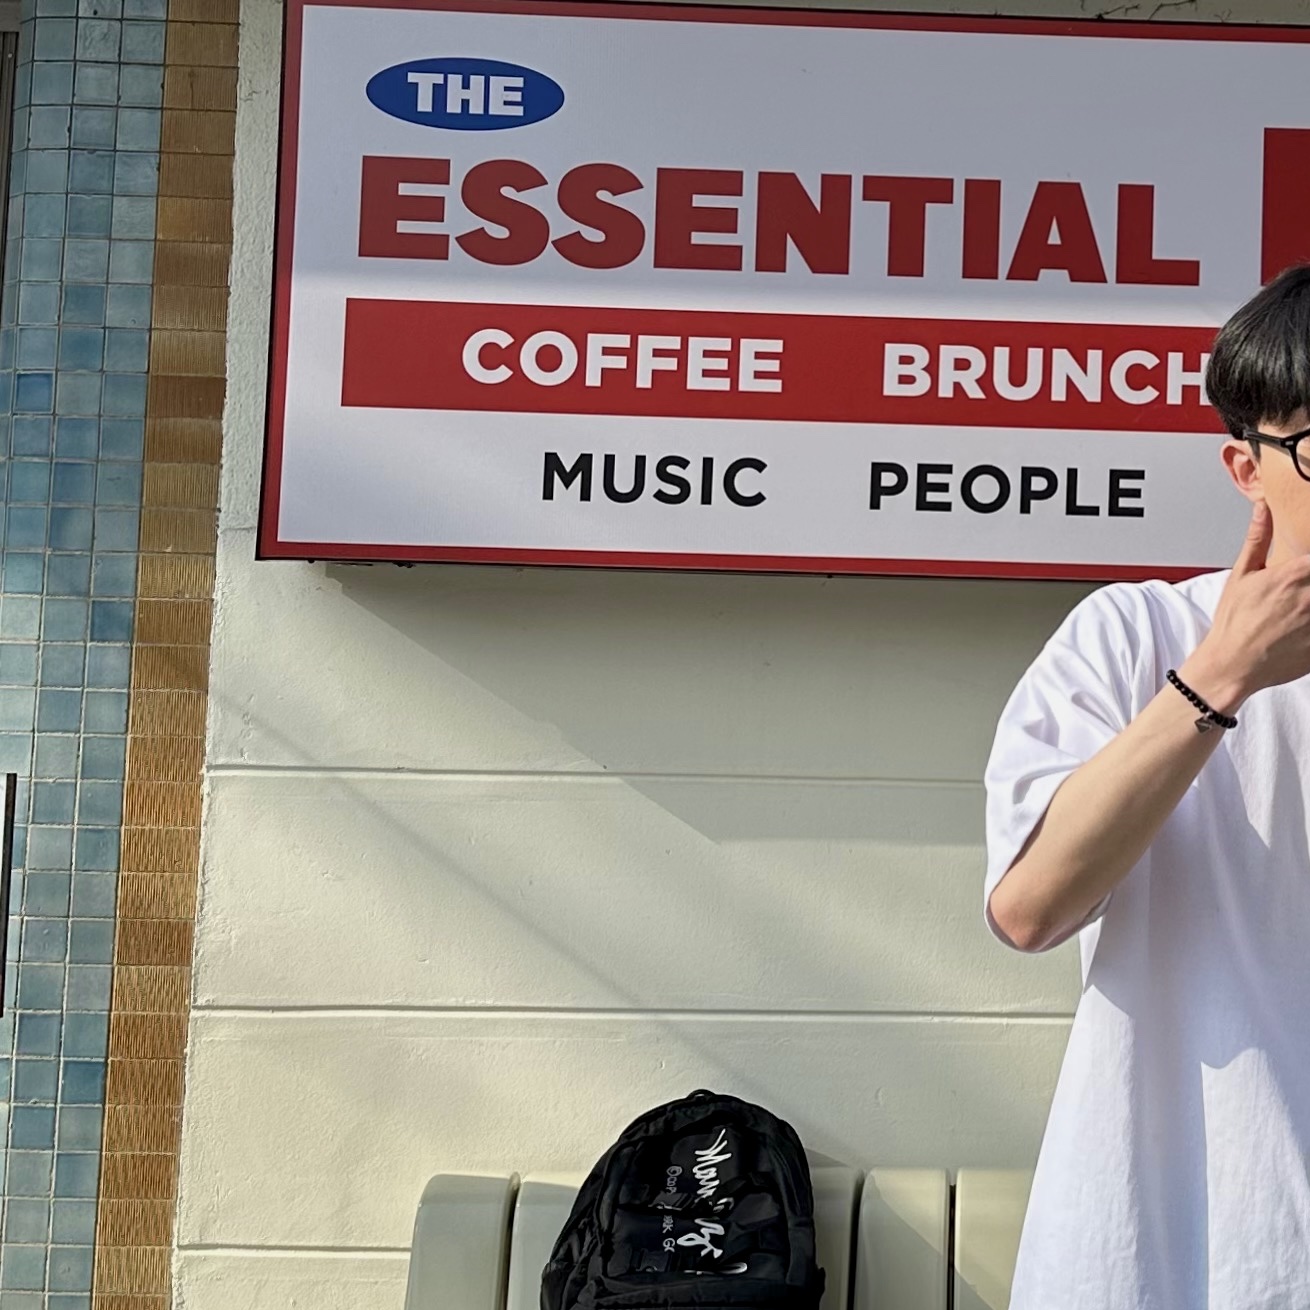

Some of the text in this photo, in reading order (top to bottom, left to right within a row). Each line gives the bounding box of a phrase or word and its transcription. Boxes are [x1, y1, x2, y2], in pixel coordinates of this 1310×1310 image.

[407, 72, 524, 116] THE
[358, 156, 1200, 286] ESSENTIAL
[462, 328, 784, 393] COFFEE
[883, 342, 1213, 406] BRUNCH
[541, 451, 768, 508] MUSIC
[869, 461, 1146, 518] PEOPLE
